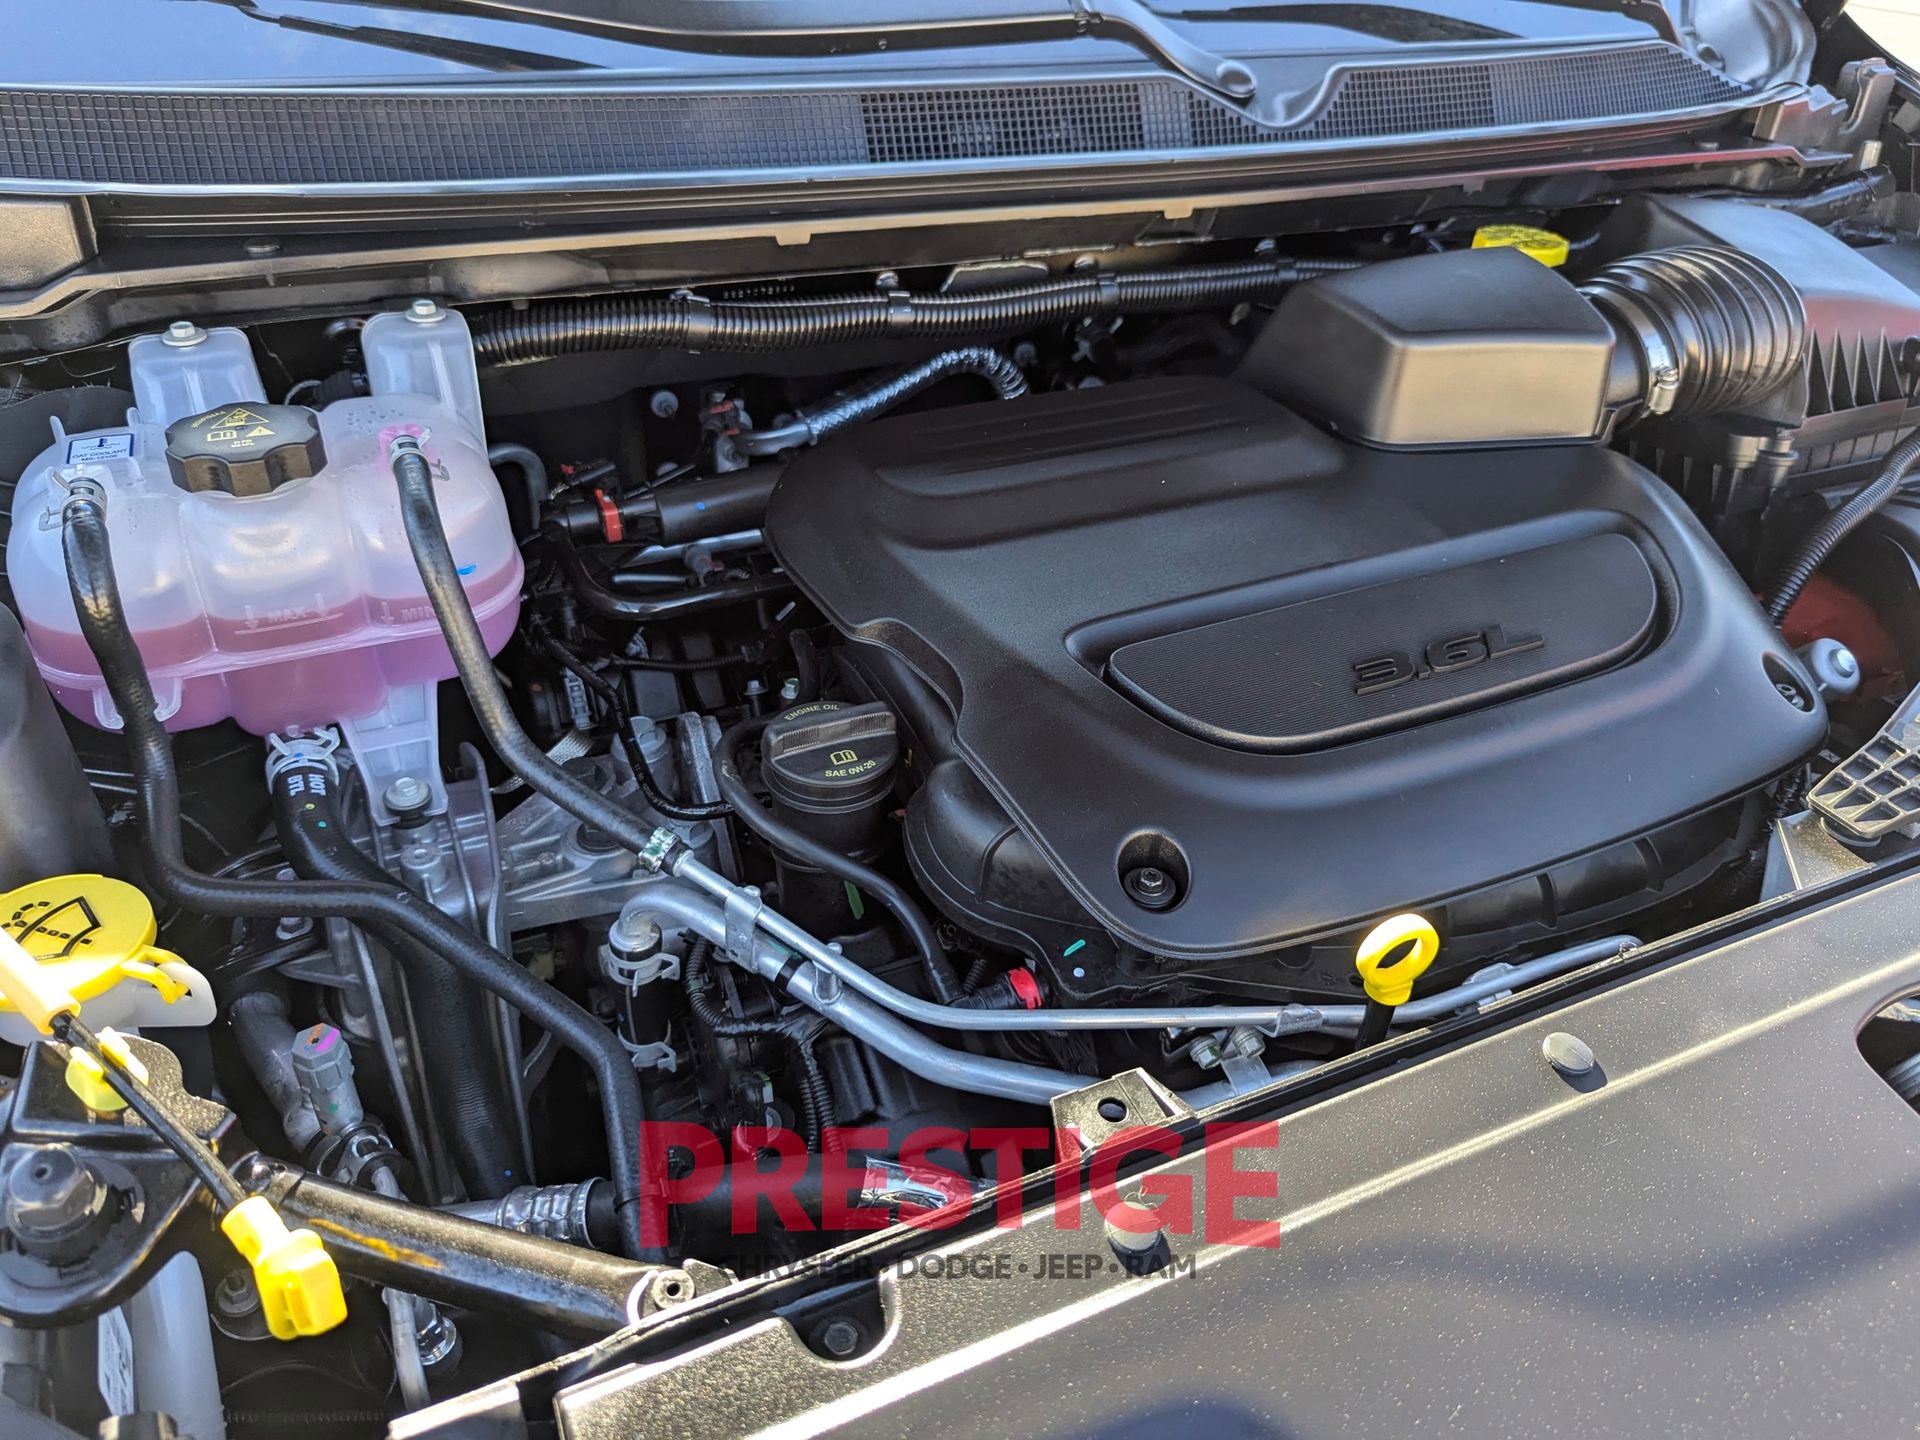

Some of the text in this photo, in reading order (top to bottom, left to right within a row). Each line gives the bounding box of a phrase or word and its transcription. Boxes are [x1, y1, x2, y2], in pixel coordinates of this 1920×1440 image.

[267, 607, 306, 623] MAX
[1353, 623, 1545, 695] 3.6L
[784, 705, 821, 721] ENGINE
[825, 760, 876, 777] SAE 0W-20
[308, 773, 326, 796] HOT
